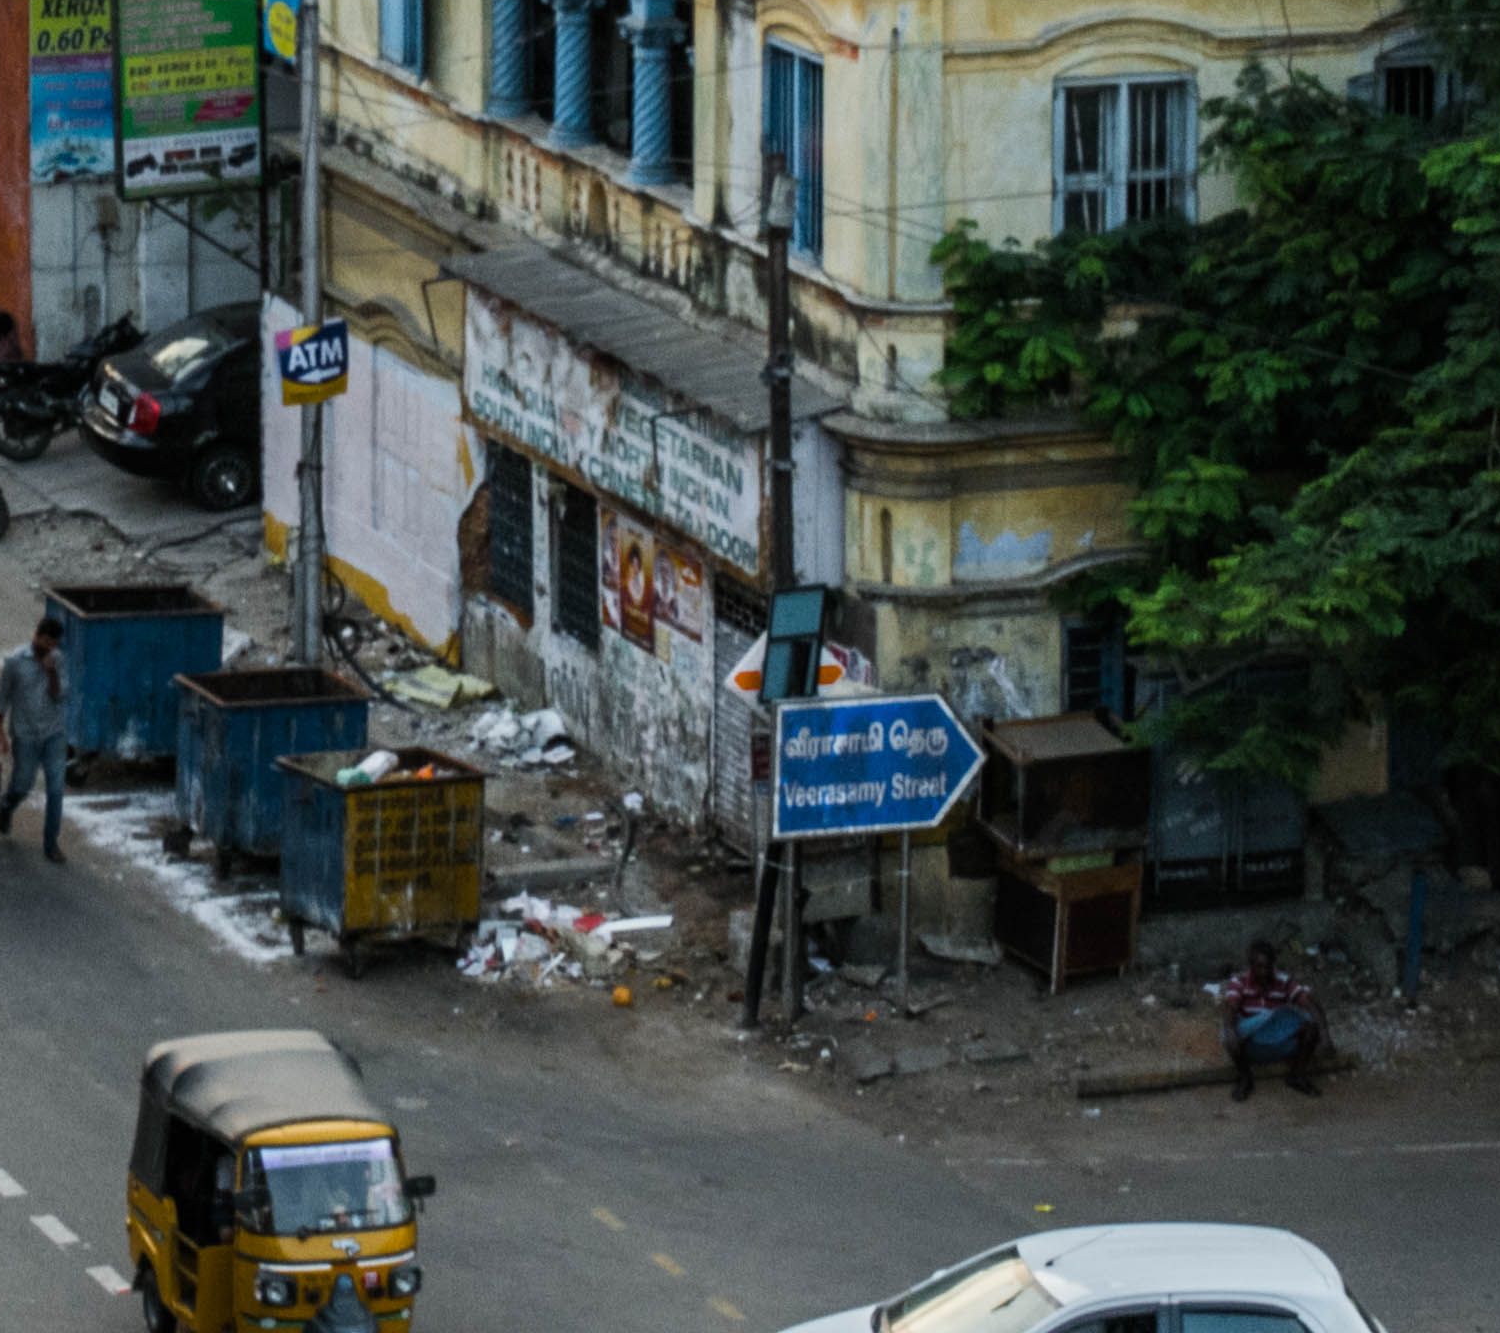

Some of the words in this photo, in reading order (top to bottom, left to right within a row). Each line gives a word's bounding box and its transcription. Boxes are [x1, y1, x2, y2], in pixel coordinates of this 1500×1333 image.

[37, 27, 84, 51] 0.60
[288, 336, 344, 373] ATM
[889, 718, 948, 758] தெரு
[783, 781, 886, 809] Veerasamy
[891, 772, 947, 801] Street
